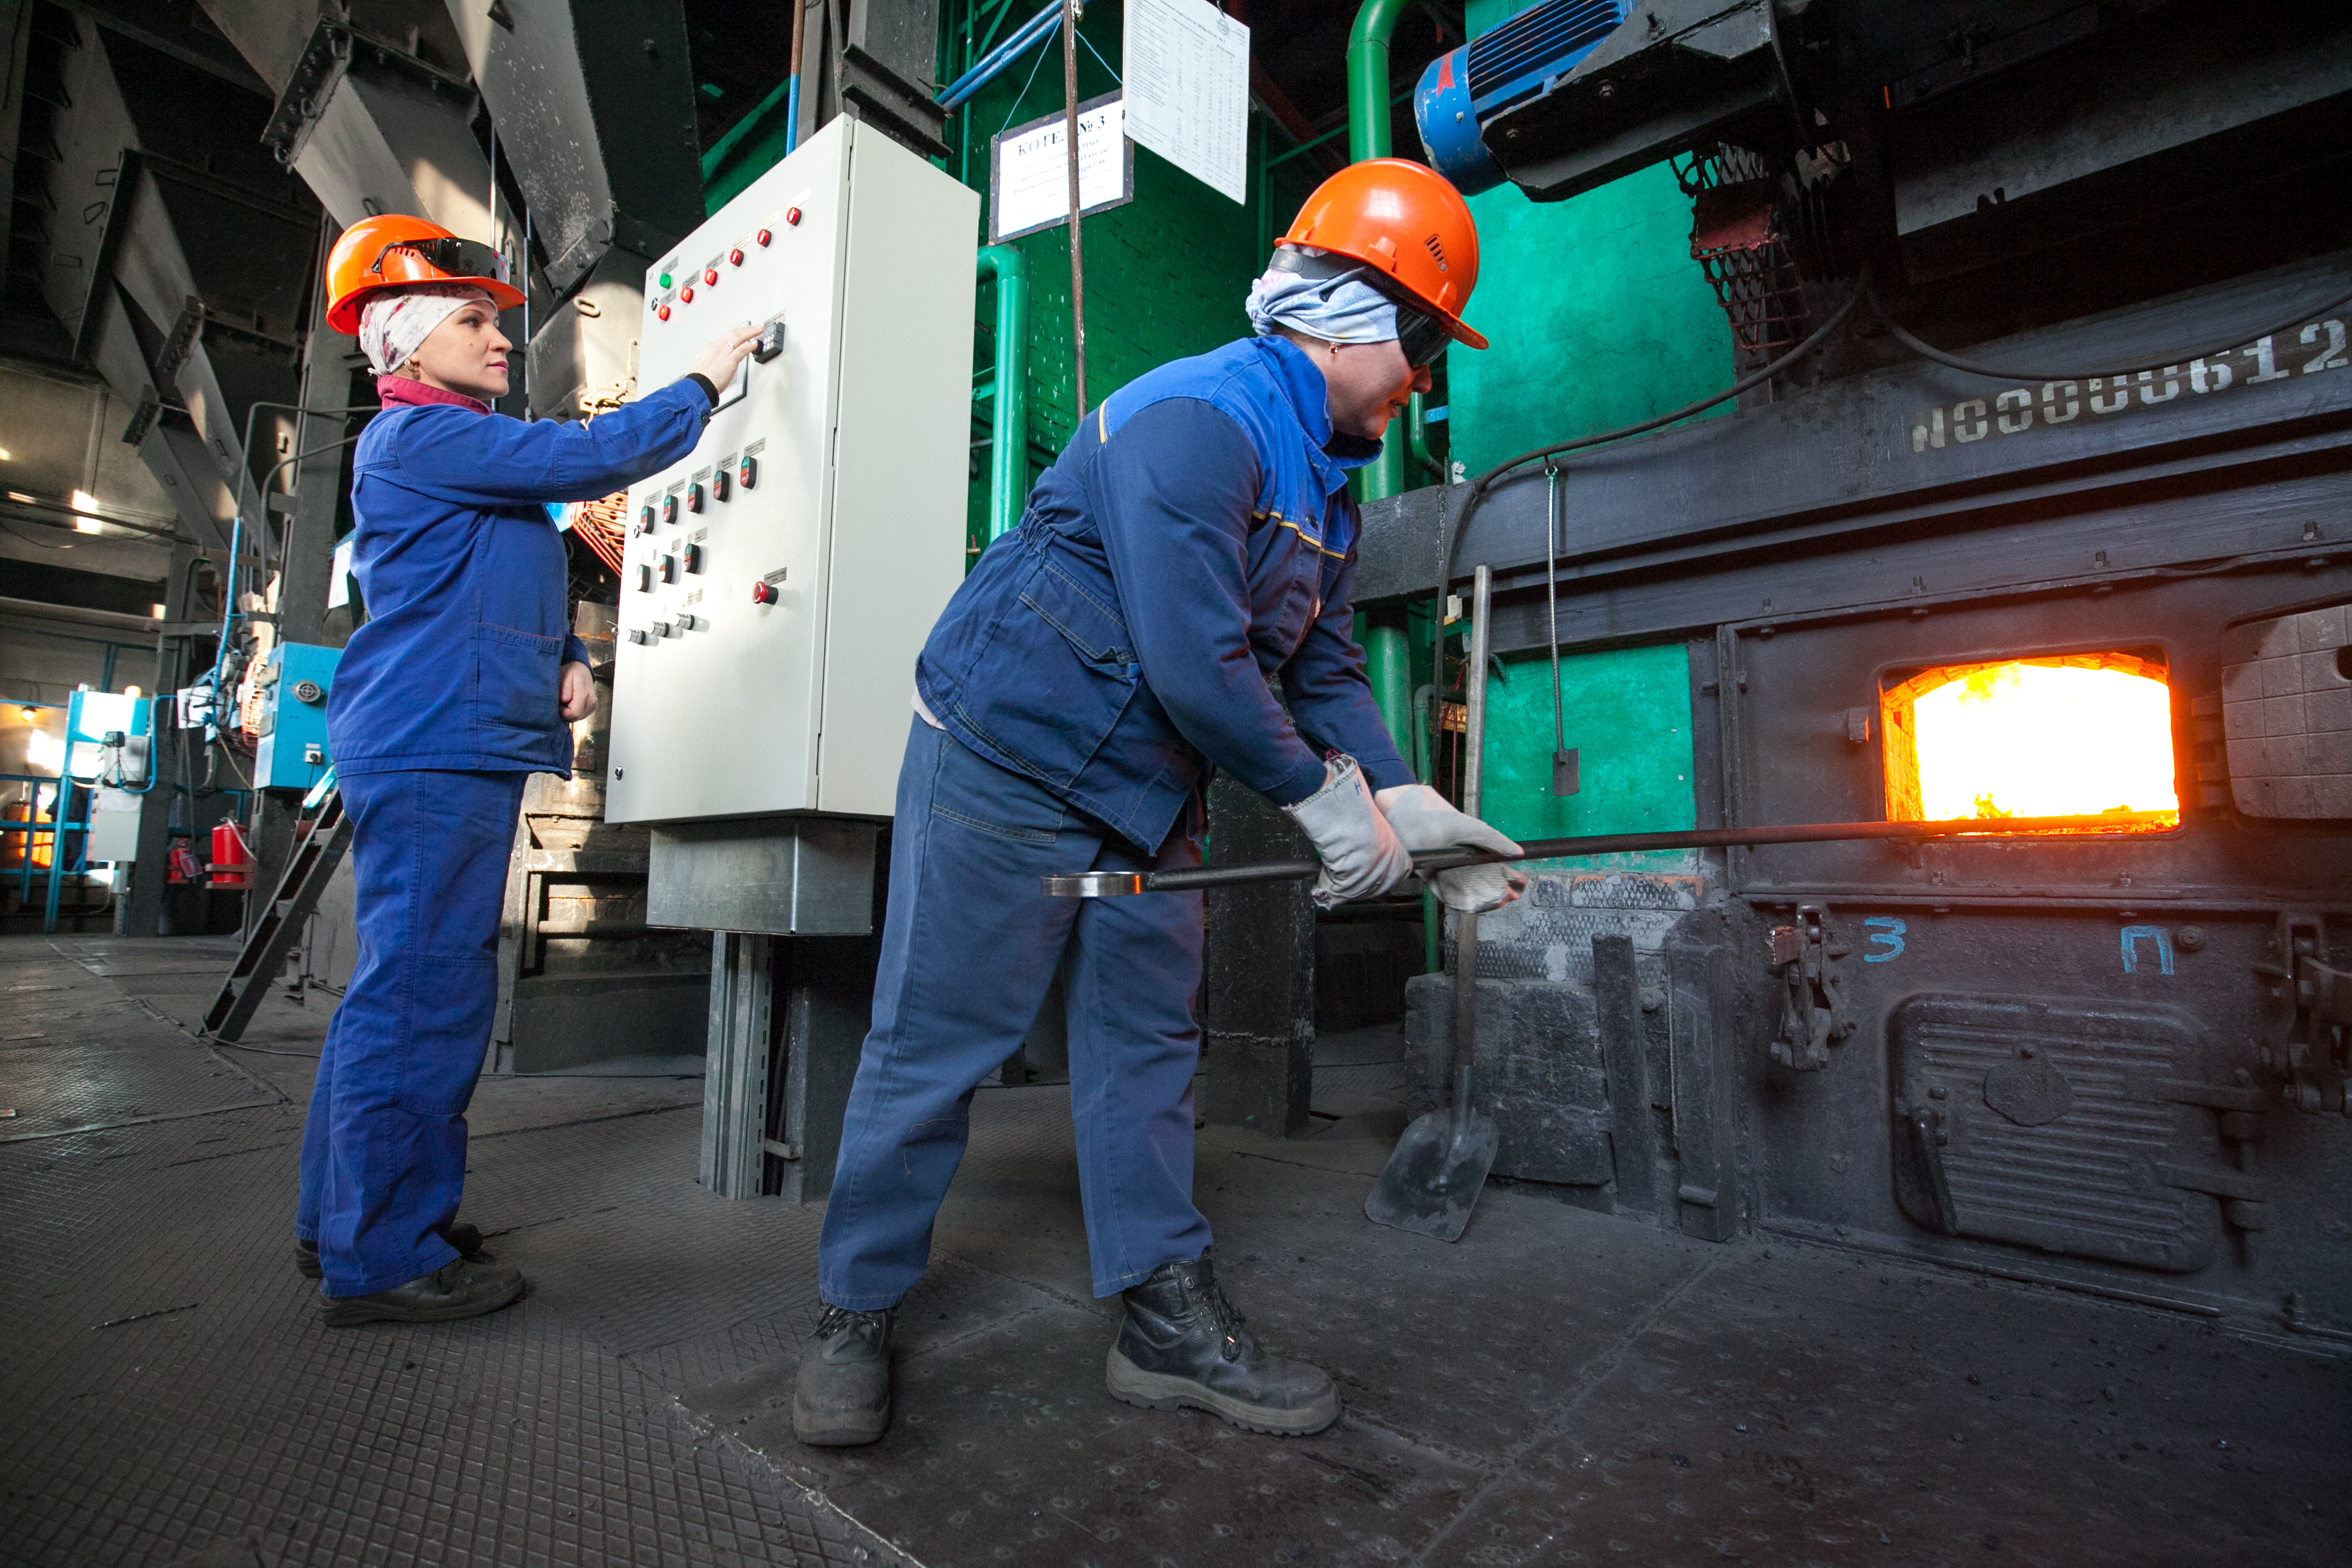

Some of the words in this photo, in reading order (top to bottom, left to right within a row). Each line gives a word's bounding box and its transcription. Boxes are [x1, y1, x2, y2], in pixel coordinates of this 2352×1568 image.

[1077, 120, 1093, 136] №
[1098, 115, 1105, 129] 3
[2120, 925, 2175, 975] П
